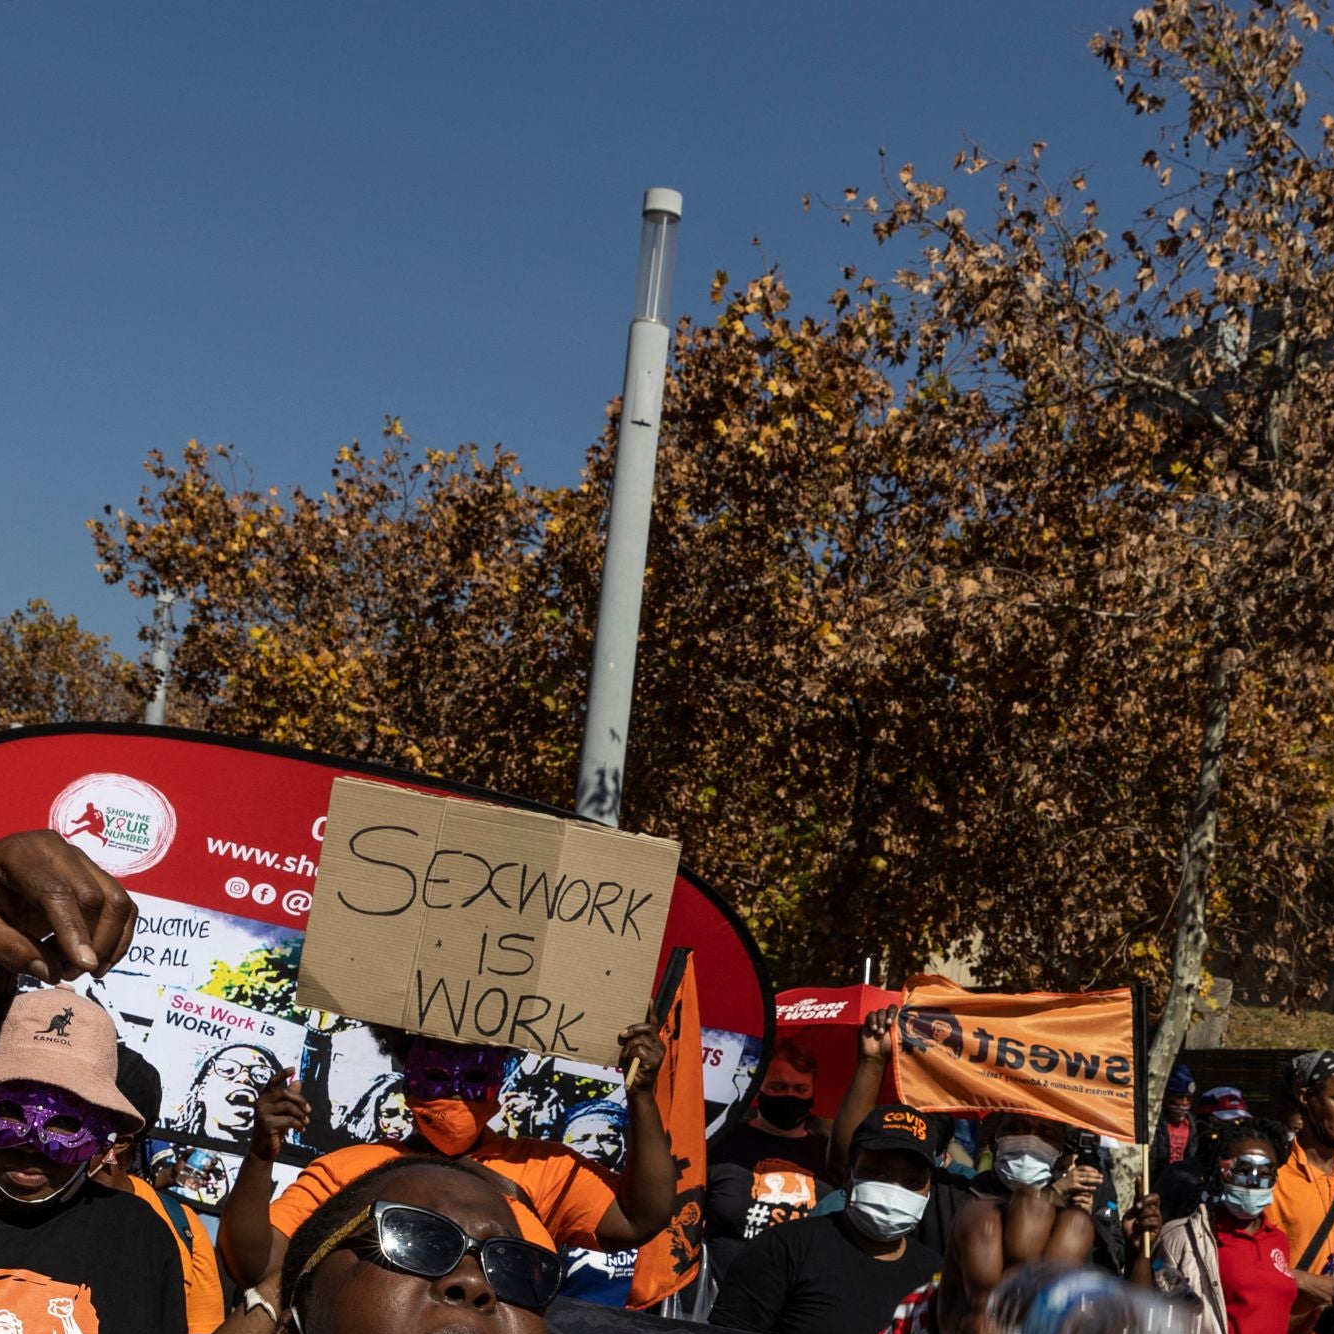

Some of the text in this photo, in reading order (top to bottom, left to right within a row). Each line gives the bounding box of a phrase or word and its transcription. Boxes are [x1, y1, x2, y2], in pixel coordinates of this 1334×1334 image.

[106, 807, 151, 823] SHOW ME
[104, 829, 150, 846] NUMBER
[338, 826, 654, 941] SEXWORK
[159, 947, 190, 967] ALL
[171, 994, 276, 1037] Sex Work is
[417, 969, 585, 1053] WORK
[166, 1010, 231, 1041] WORK!
[33, 1035, 72, 1047] KANGOL
[883, 1111, 927, 1131] COVID
[912, 1125, 927, 1141] 19
